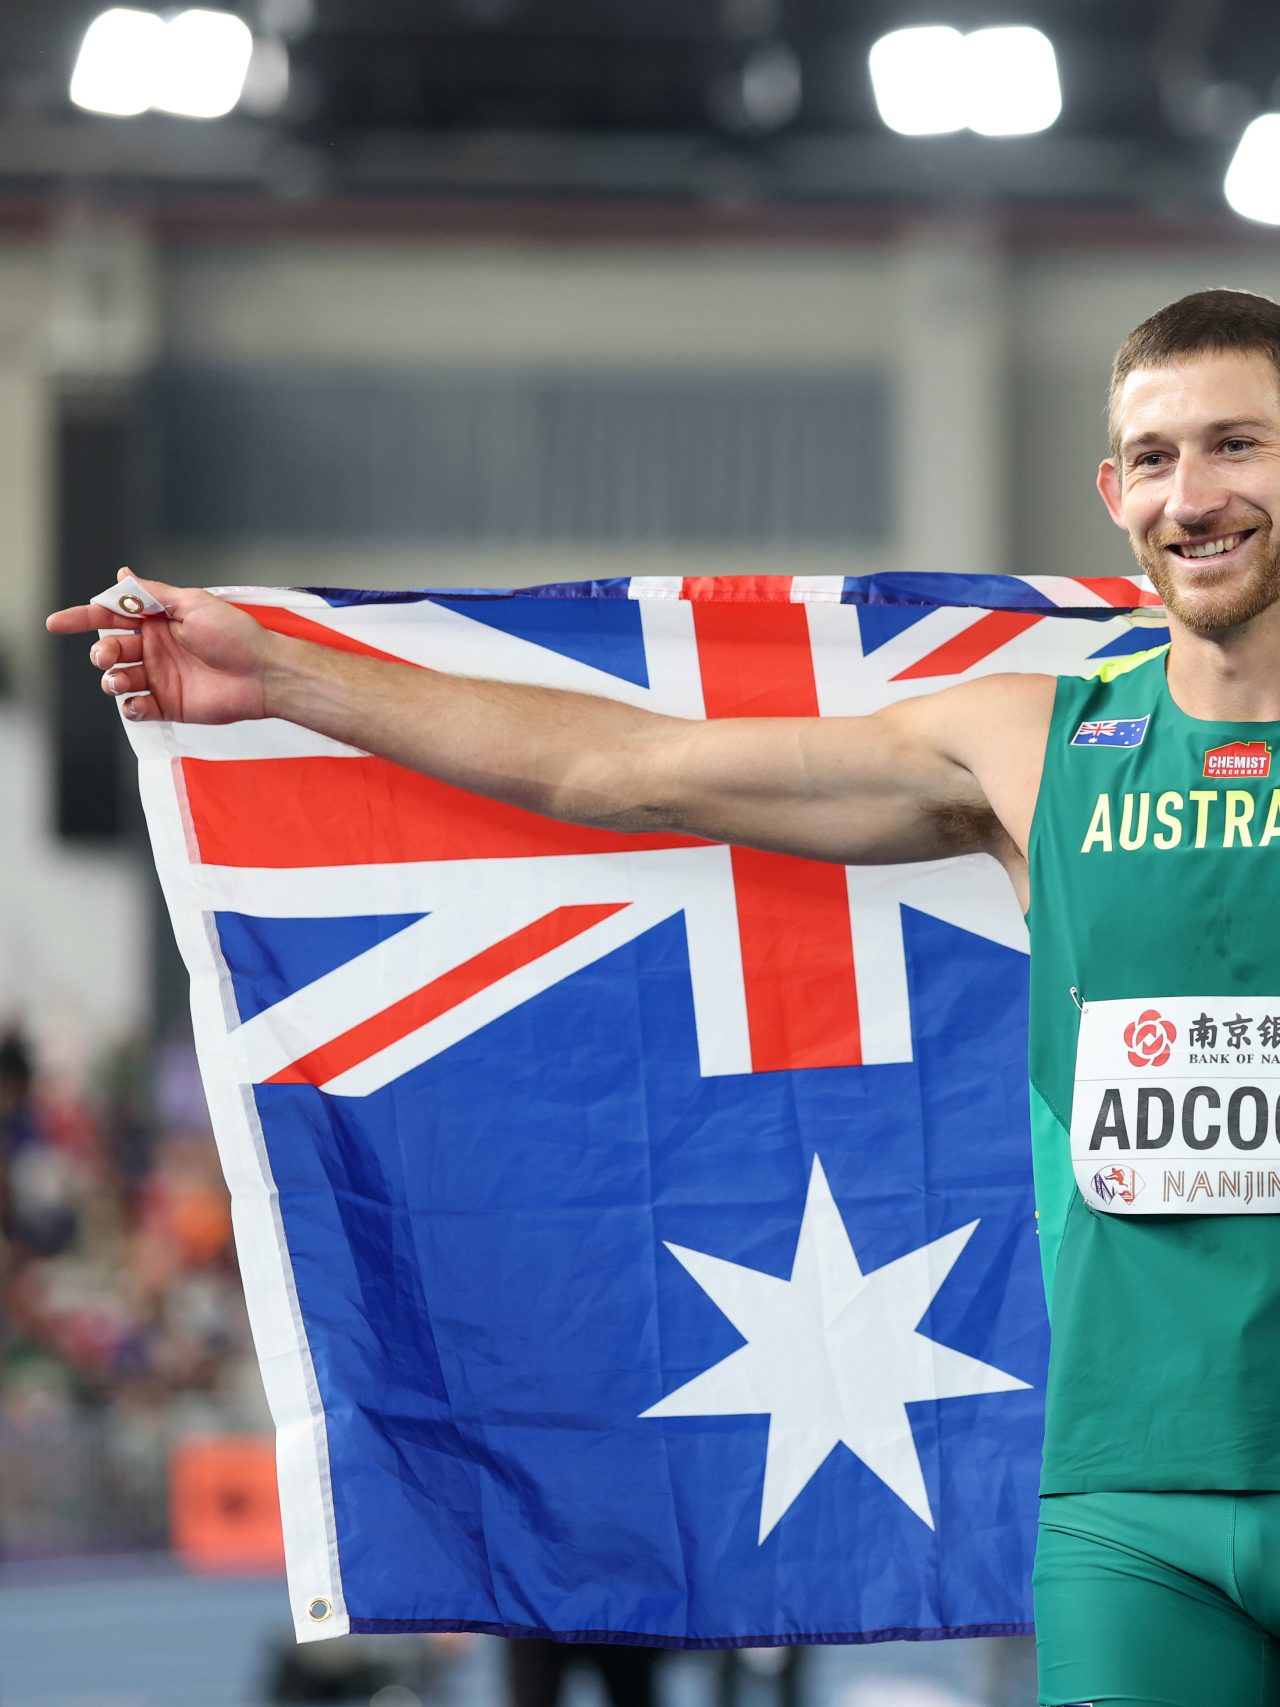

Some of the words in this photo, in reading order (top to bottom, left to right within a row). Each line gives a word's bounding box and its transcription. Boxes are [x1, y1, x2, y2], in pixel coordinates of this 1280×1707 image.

[1208, 756, 1267, 769] CHEMIST
[1189, 1053, 1230, 1064] BANK
[1236, 1053, 1254, 1064] OF
